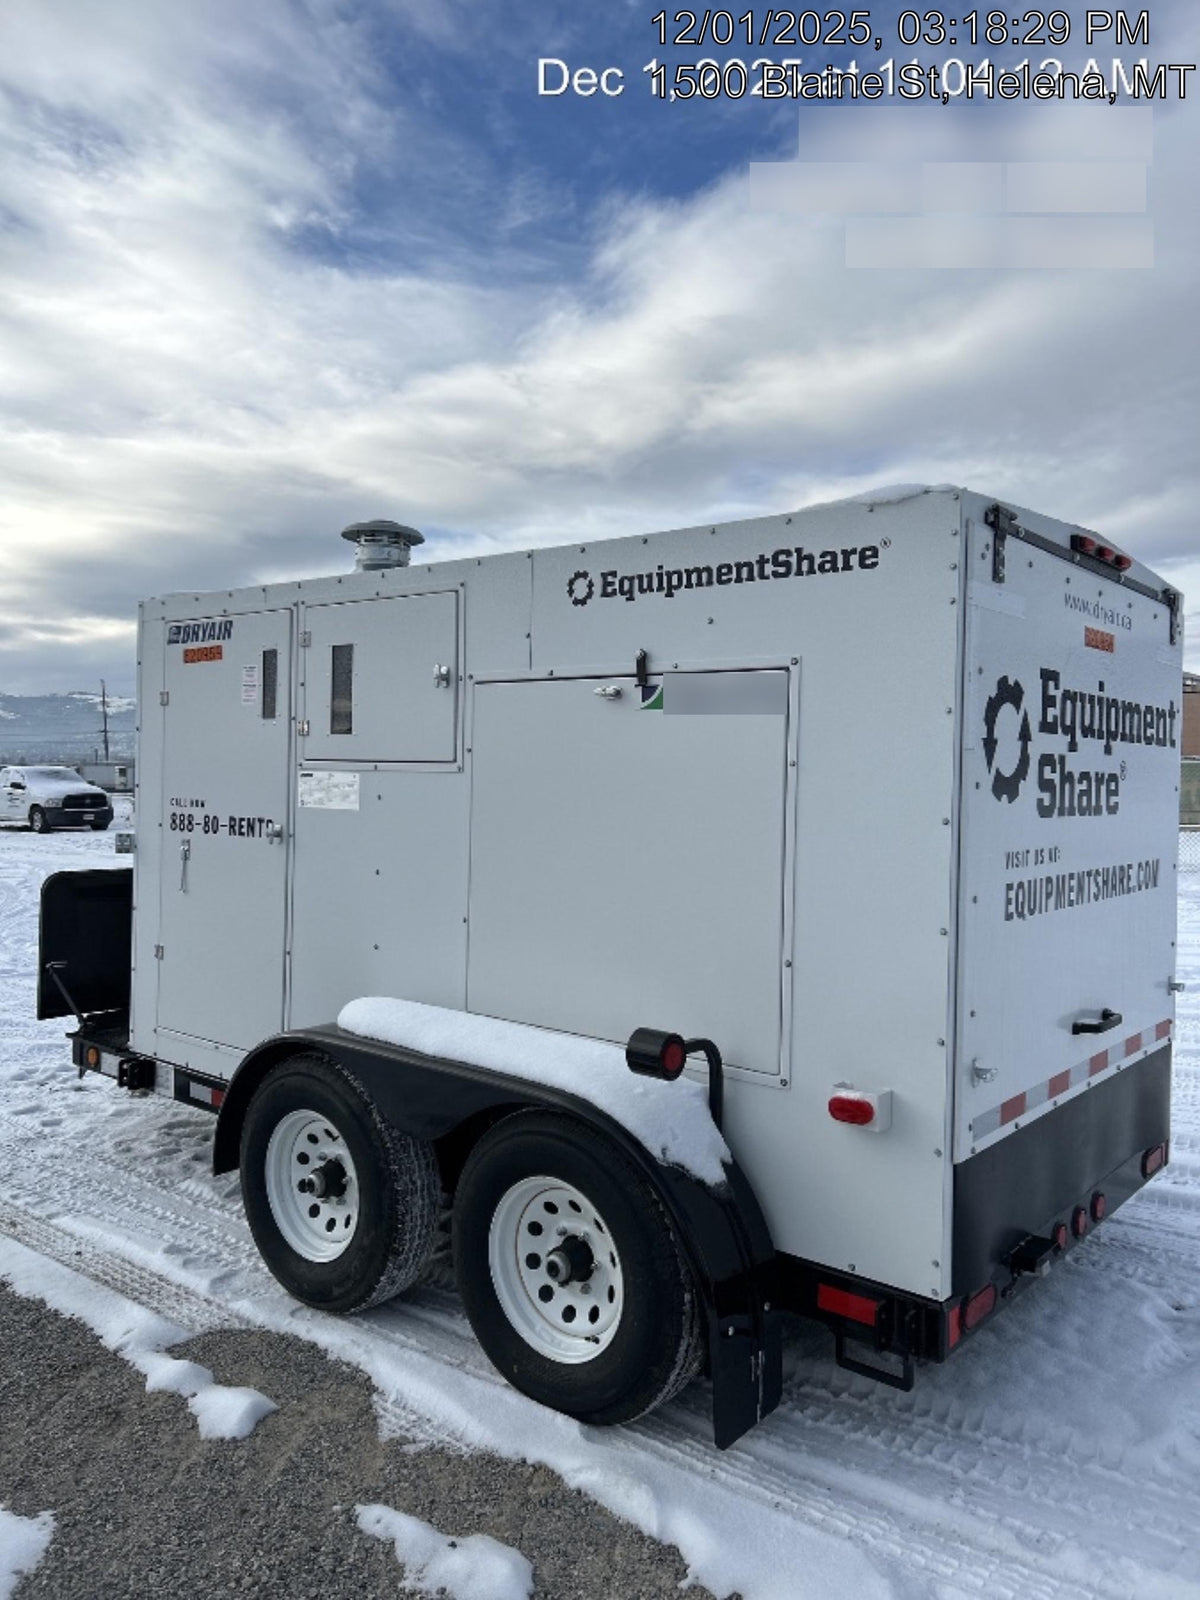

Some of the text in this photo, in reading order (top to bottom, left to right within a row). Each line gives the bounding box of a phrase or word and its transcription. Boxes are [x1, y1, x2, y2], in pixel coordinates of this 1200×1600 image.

[180, 619, 234, 644] DRYAIR
[1038, 668, 1177, 755] Equipment
[1005, 850, 1030, 870] VISIT
[1034, 848, 1045, 866] US
